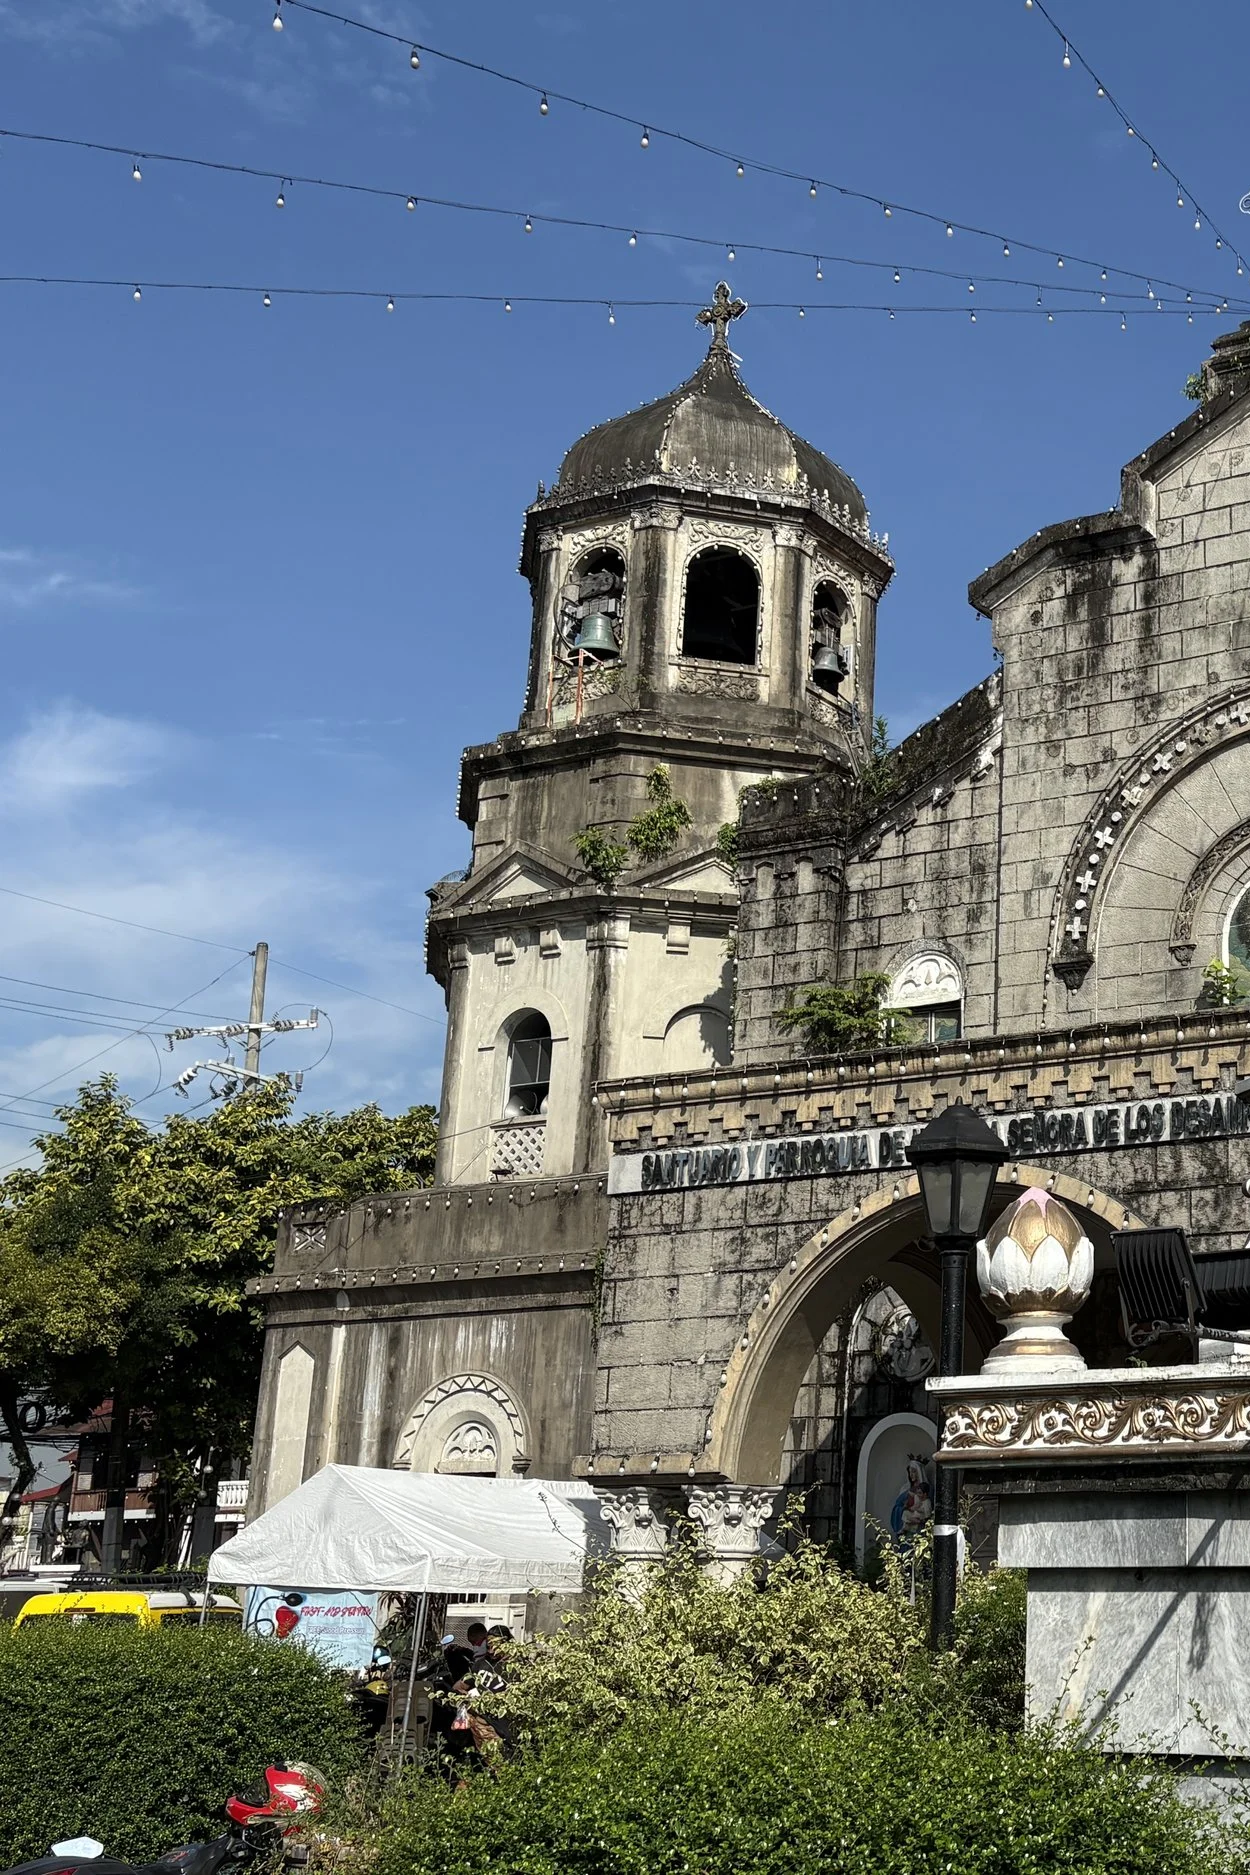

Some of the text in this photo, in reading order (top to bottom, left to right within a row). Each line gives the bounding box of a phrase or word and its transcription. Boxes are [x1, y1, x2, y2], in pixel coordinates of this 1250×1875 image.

[642, 1147, 742, 1190] SANTUARIO
[747, 1145, 762, 1180] Y
[765, 1135, 872, 1178] PARROQUIA
[879, 1131, 906, 1167] DE
[1008, 1110, 1089, 1155] SEÑORA
[1093, 1109, 1120, 1148] DE
[1125, 1103, 1165, 1144] LOS
